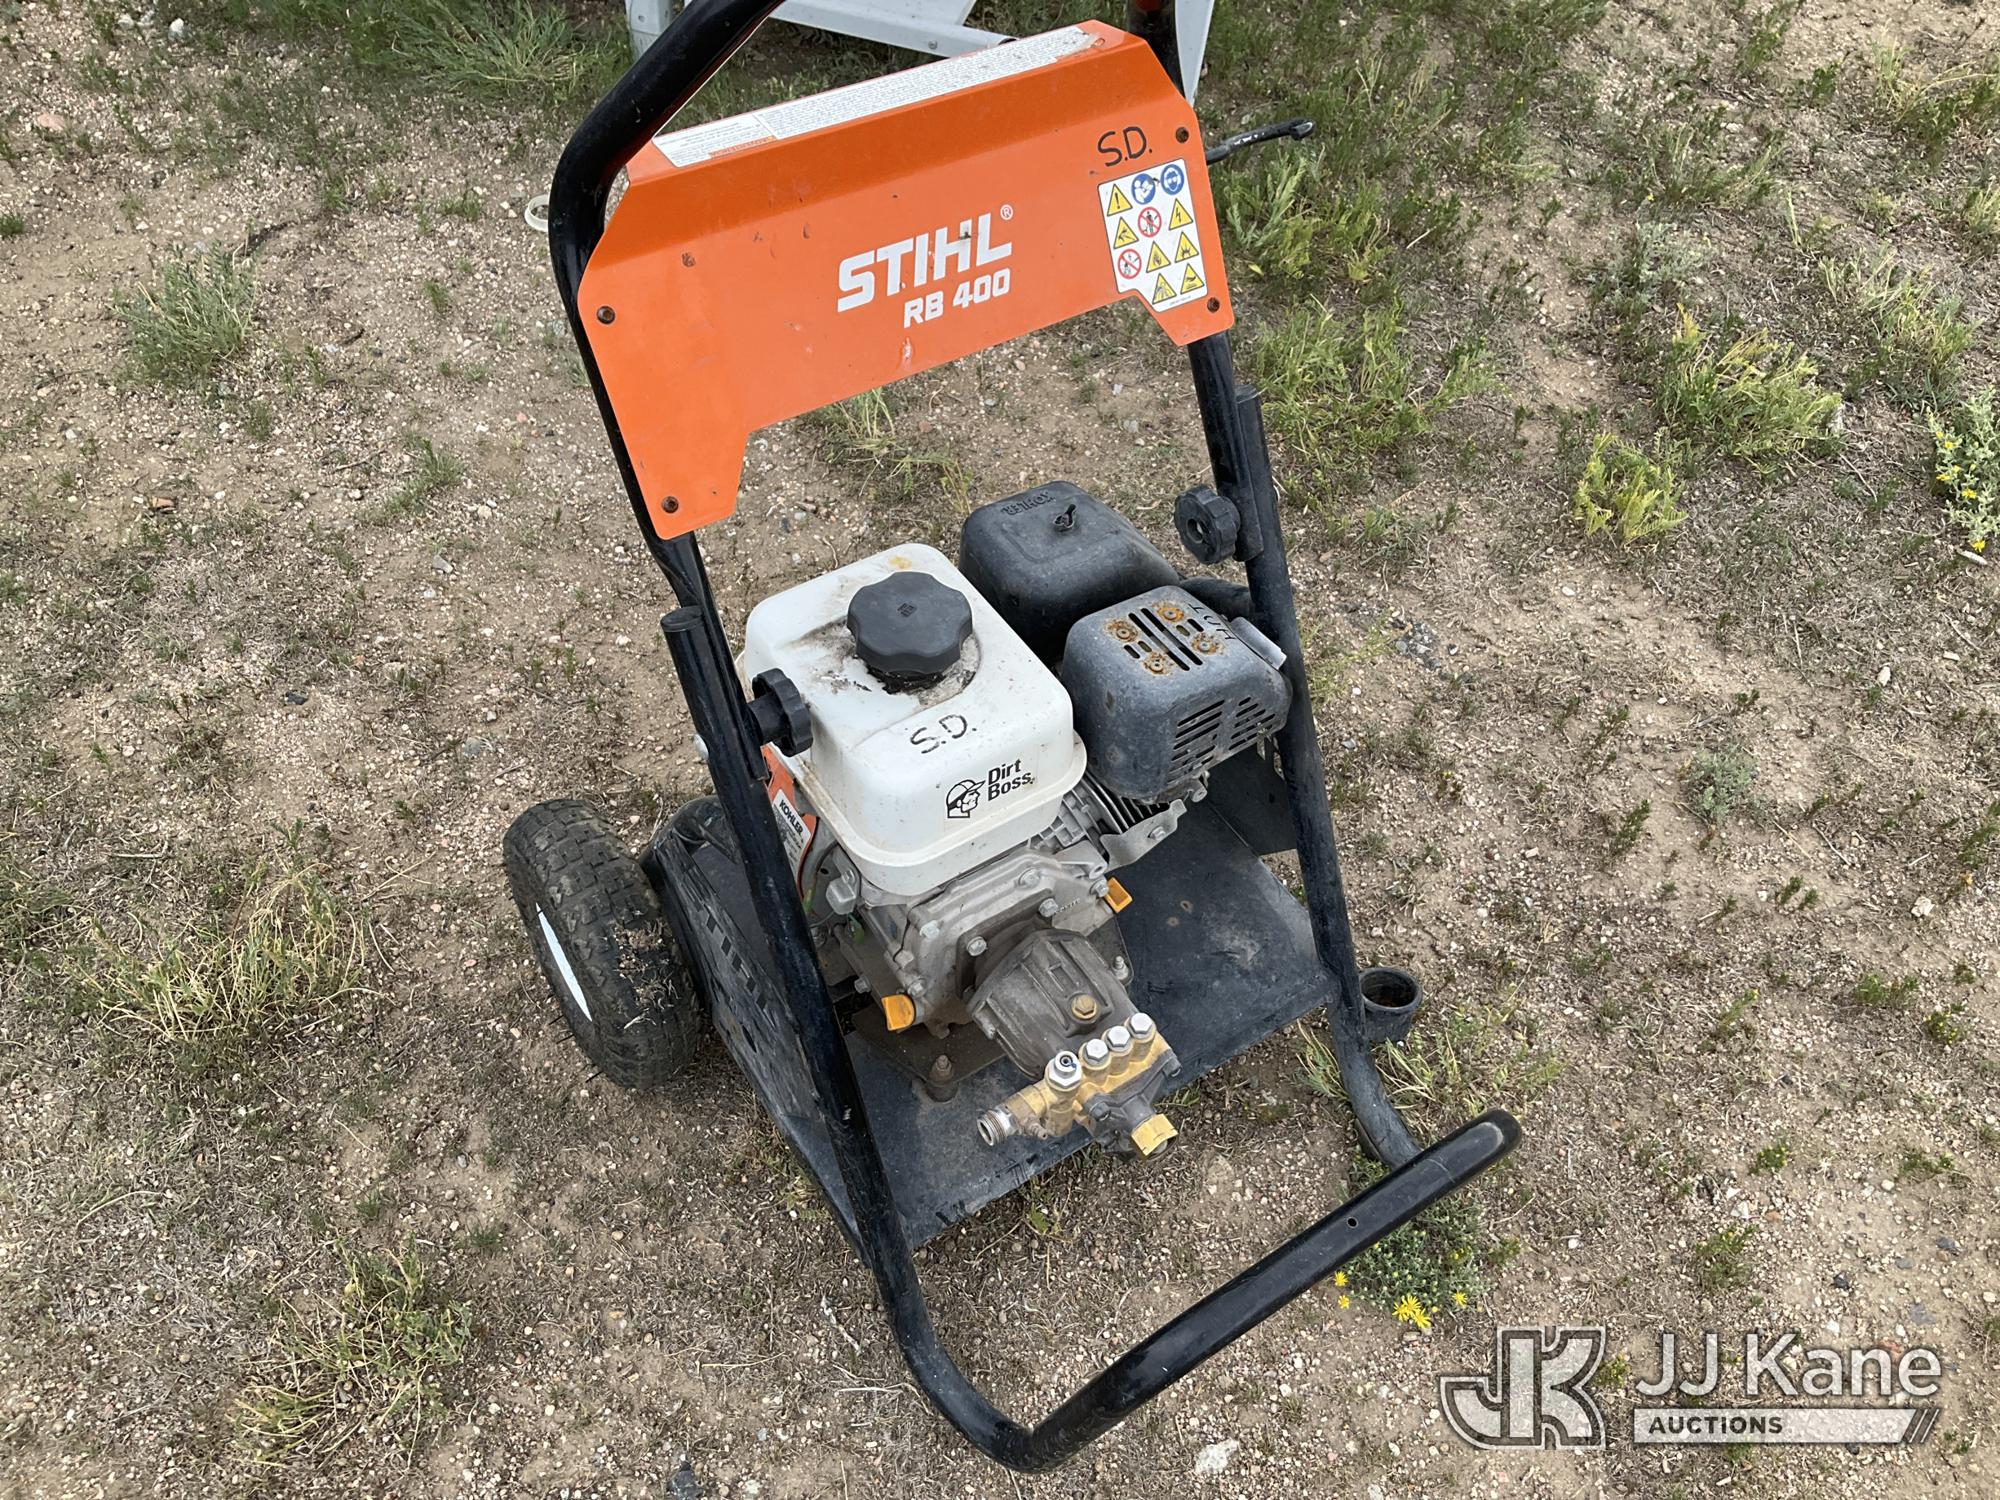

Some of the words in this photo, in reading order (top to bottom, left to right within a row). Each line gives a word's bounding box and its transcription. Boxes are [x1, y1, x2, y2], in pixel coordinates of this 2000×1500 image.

[1097, 126, 1152, 167] S.D.
[903, 290, 944, 329] RB
[952, 267, 1011, 309] 400
[1187, 603, 1236, 640] HOT
[910, 714, 977, 754] S.D.
[988, 759, 1021, 785] Dirt
[779, 799, 804, 836] KOHLER
